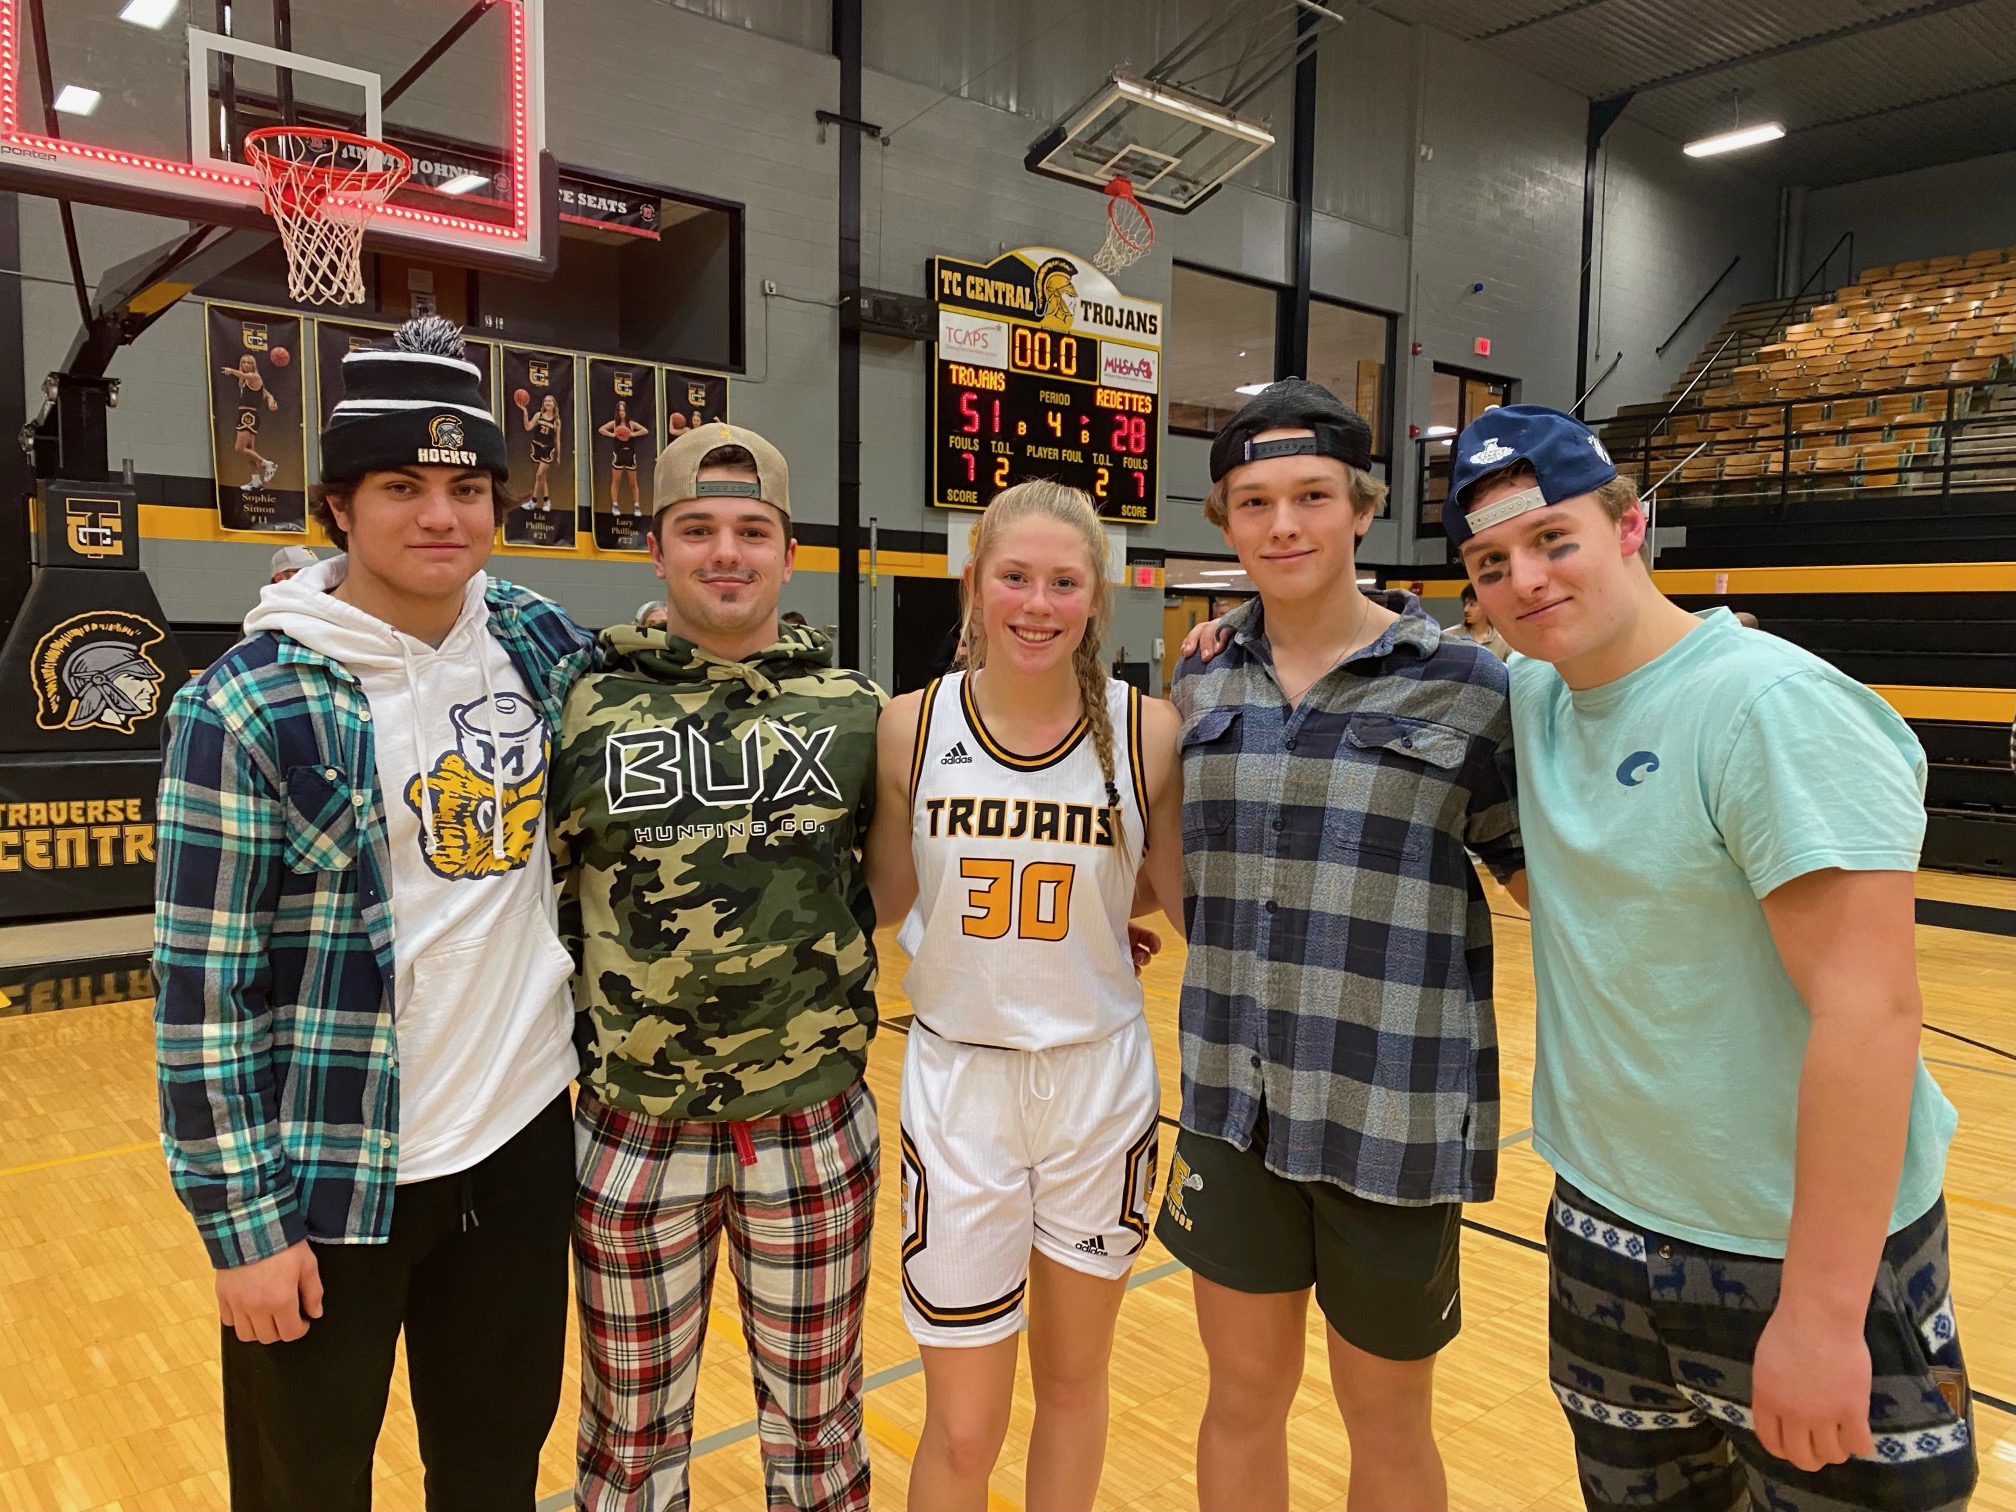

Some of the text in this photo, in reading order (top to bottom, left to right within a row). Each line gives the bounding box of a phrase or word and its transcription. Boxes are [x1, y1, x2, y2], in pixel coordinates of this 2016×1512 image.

[577, 193, 627, 214] SEATS
[941, 269, 1034, 311] TC CENTRAL
[1080, 301, 1158, 335] TROJANS
[946, 326, 989, 349] TCAPS
[1014, 327, 1077, 376] 00.0
[949, 364, 1006, 392] TROJANS
[1040, 390, 1071, 406] PERIOD
[1096, 388, 1152, 414] REDETTES
[960, 392, 1000, 433] 51
[1018, 420, 1027, 435] B
[1047, 411, 1061, 437] 4
[1112, 414, 1146, 454] 28
[949, 435, 980, 451] FOULS
[1081, 430, 1090, 443] B
[417, 448, 478, 467] HOCKEY
[991, 440, 1014, 455] T.O.L.
[1026, 444, 1083, 463] PLAYER FOUL
[962, 452, 975, 482] 7
[1093, 452, 1113, 467] T.O.L.
[1123, 456, 1148, 471] FOULS
[995, 457, 1009, 487] 2
[1095, 468, 1109, 497] 2
[1133, 471, 1145, 498] 7
[241, 493, 276, 504] Sophie
[947, 488, 978, 503] SCORE
[243, 504, 275, 514] Simon
[533, 512, 546, 521] Liz
[1121, 504, 1147, 518] SCORE
[525, 521, 554, 532] Phillips
[533, 531, 547, 540] #21
[611, 527, 639, 537] Phillips
[476, 739, 525, 776] M
[605, 719, 843, 814] BUX
[940, 755, 973, 765] adidas
[634, 818, 826, 843] HUNTING CO.
[926, 796, 1123, 848] TROJANS
[960, 857, 1076, 942] 30
